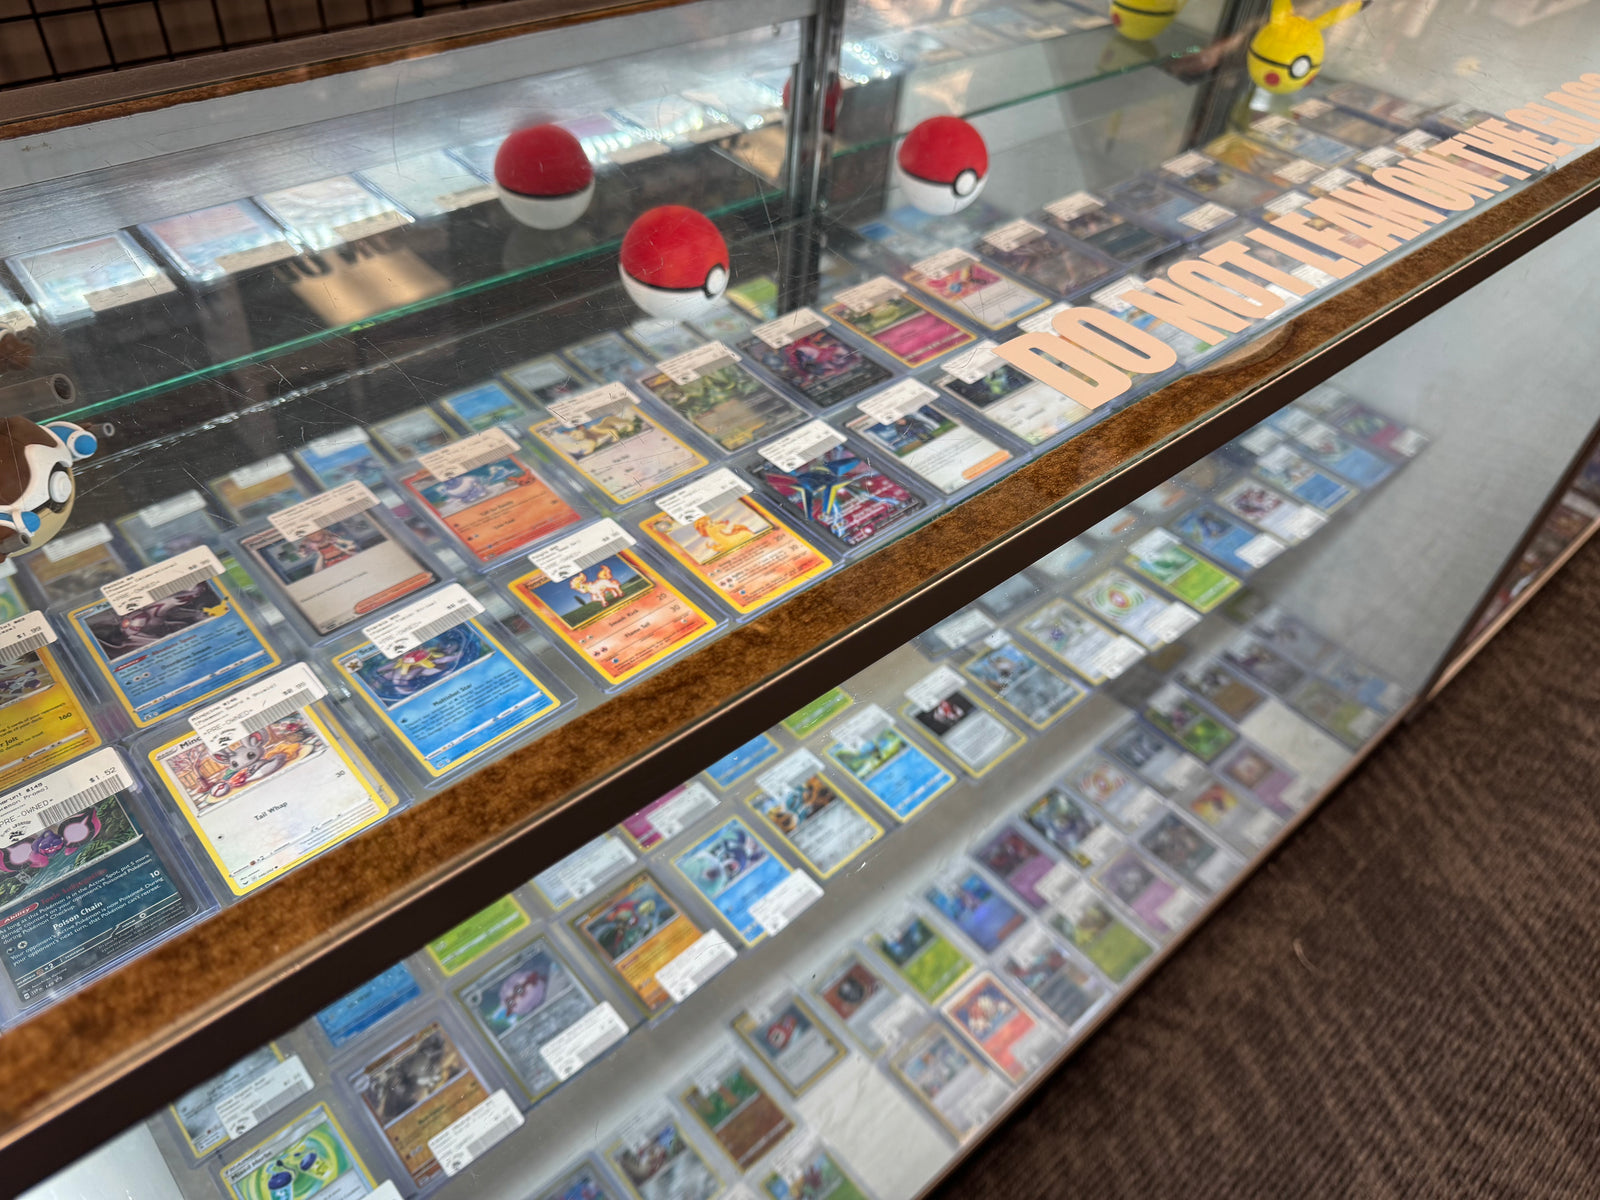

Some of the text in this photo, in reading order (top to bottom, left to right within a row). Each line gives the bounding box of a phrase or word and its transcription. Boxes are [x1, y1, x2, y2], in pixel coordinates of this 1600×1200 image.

[1504, 73, 1600, 145] GLA
[1429, 117, 1575, 180] THE
[1372, 152, 1510, 211] ON
[1244, 180, 1448, 279] LEAN
[1119, 240, 1317, 346] NOT
[991, 307, 1177, 410] DO
[254, 811, 267, 822] Tail
[149, 869, 160, 878] 10
[52, 900, 103, 930] Poison Chain
